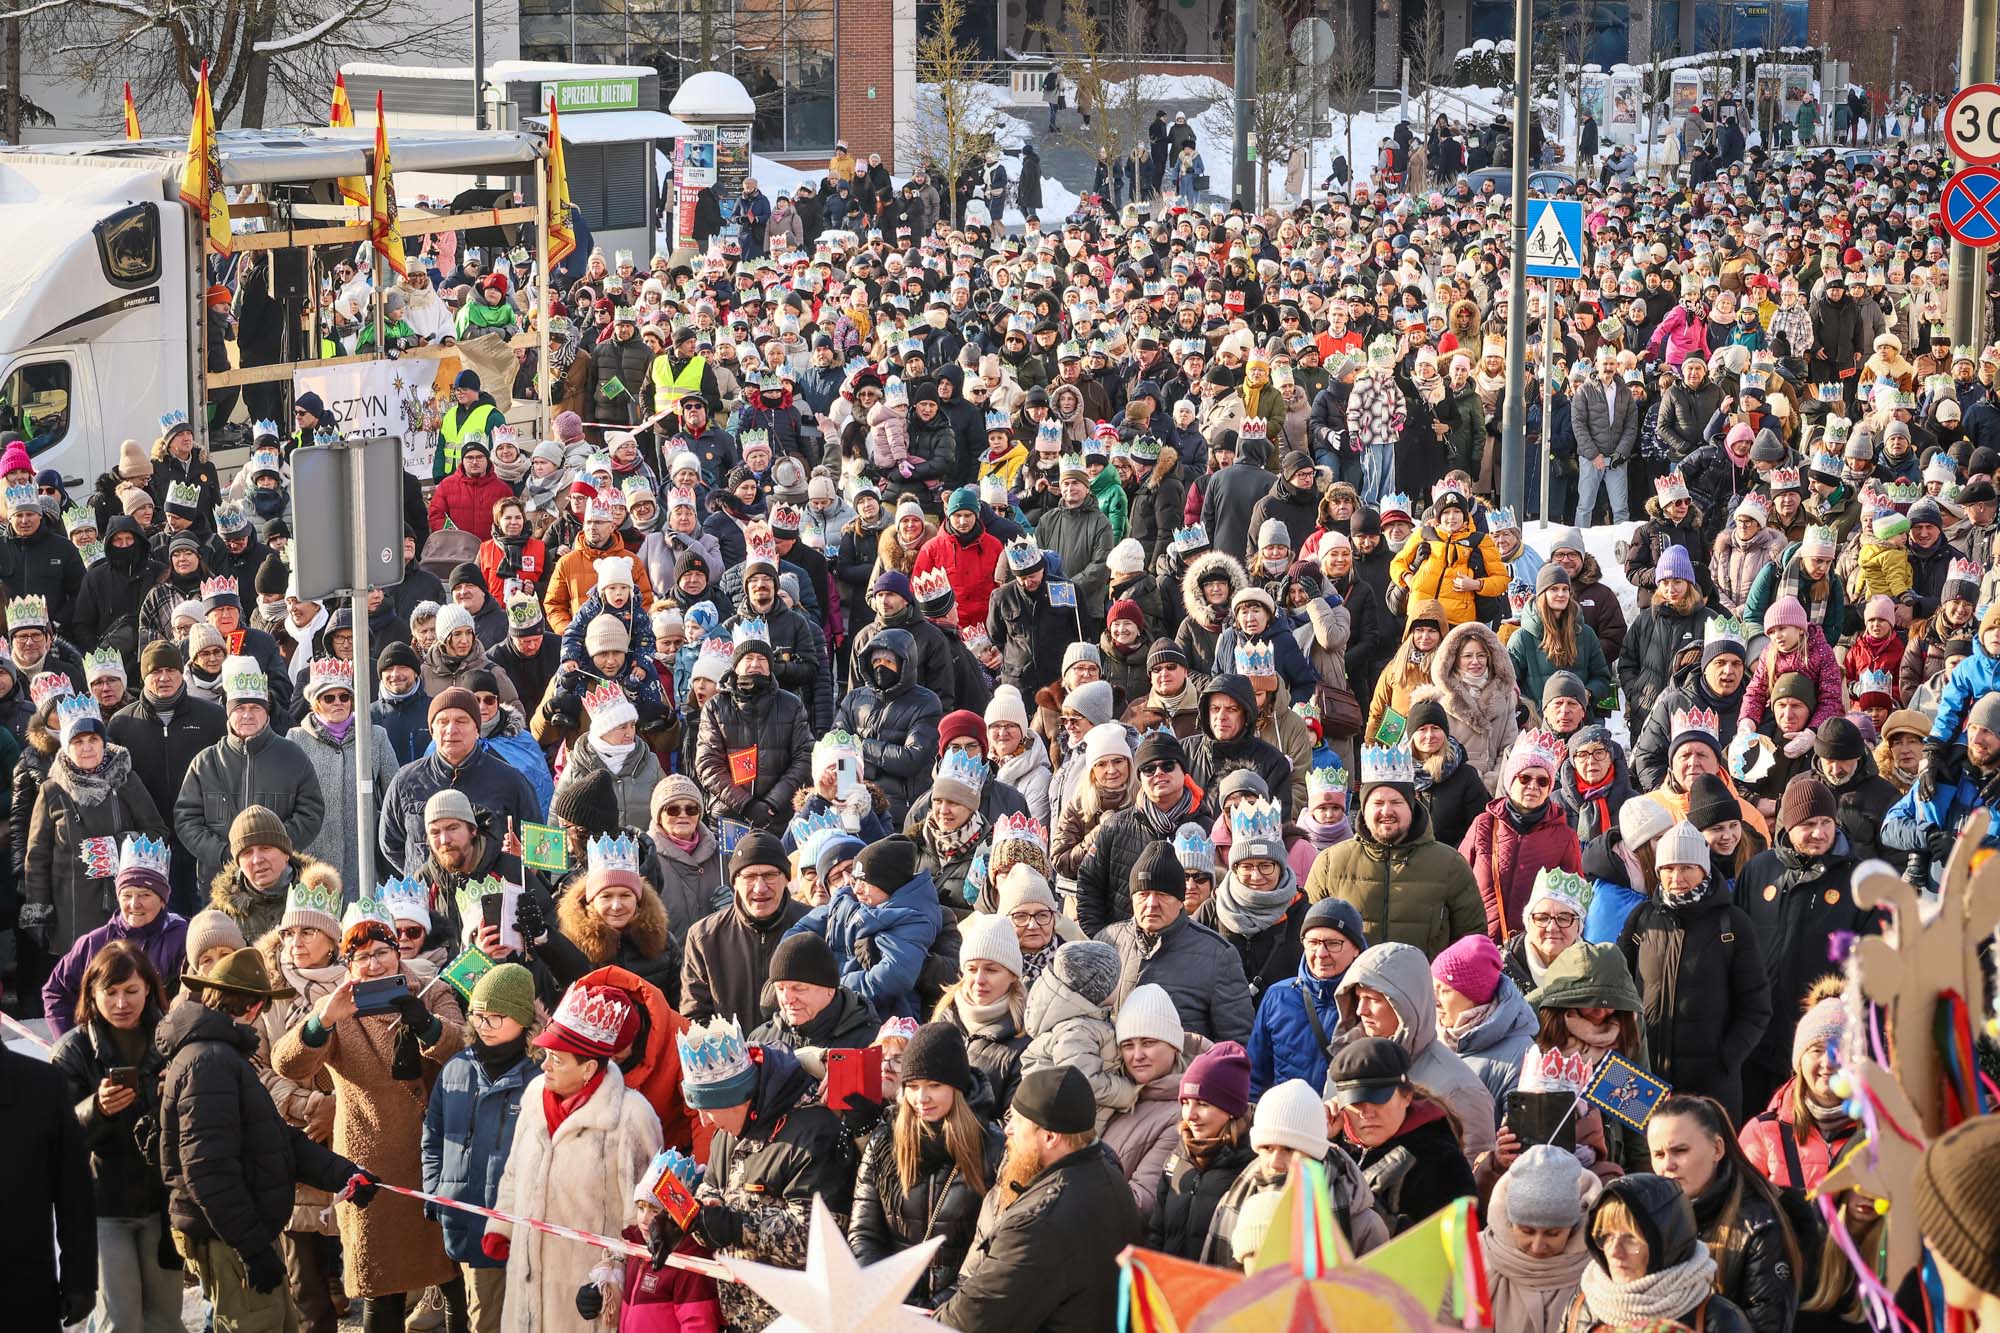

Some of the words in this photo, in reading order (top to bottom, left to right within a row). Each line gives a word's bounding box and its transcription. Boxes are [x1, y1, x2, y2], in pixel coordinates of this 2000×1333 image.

[561, 82, 598, 106] SPRZEDAŻ
[601, 81, 633, 103] BILETÓW
[1956, 105, 2000, 144] 30
[332, 394, 388, 423] SZTYN
